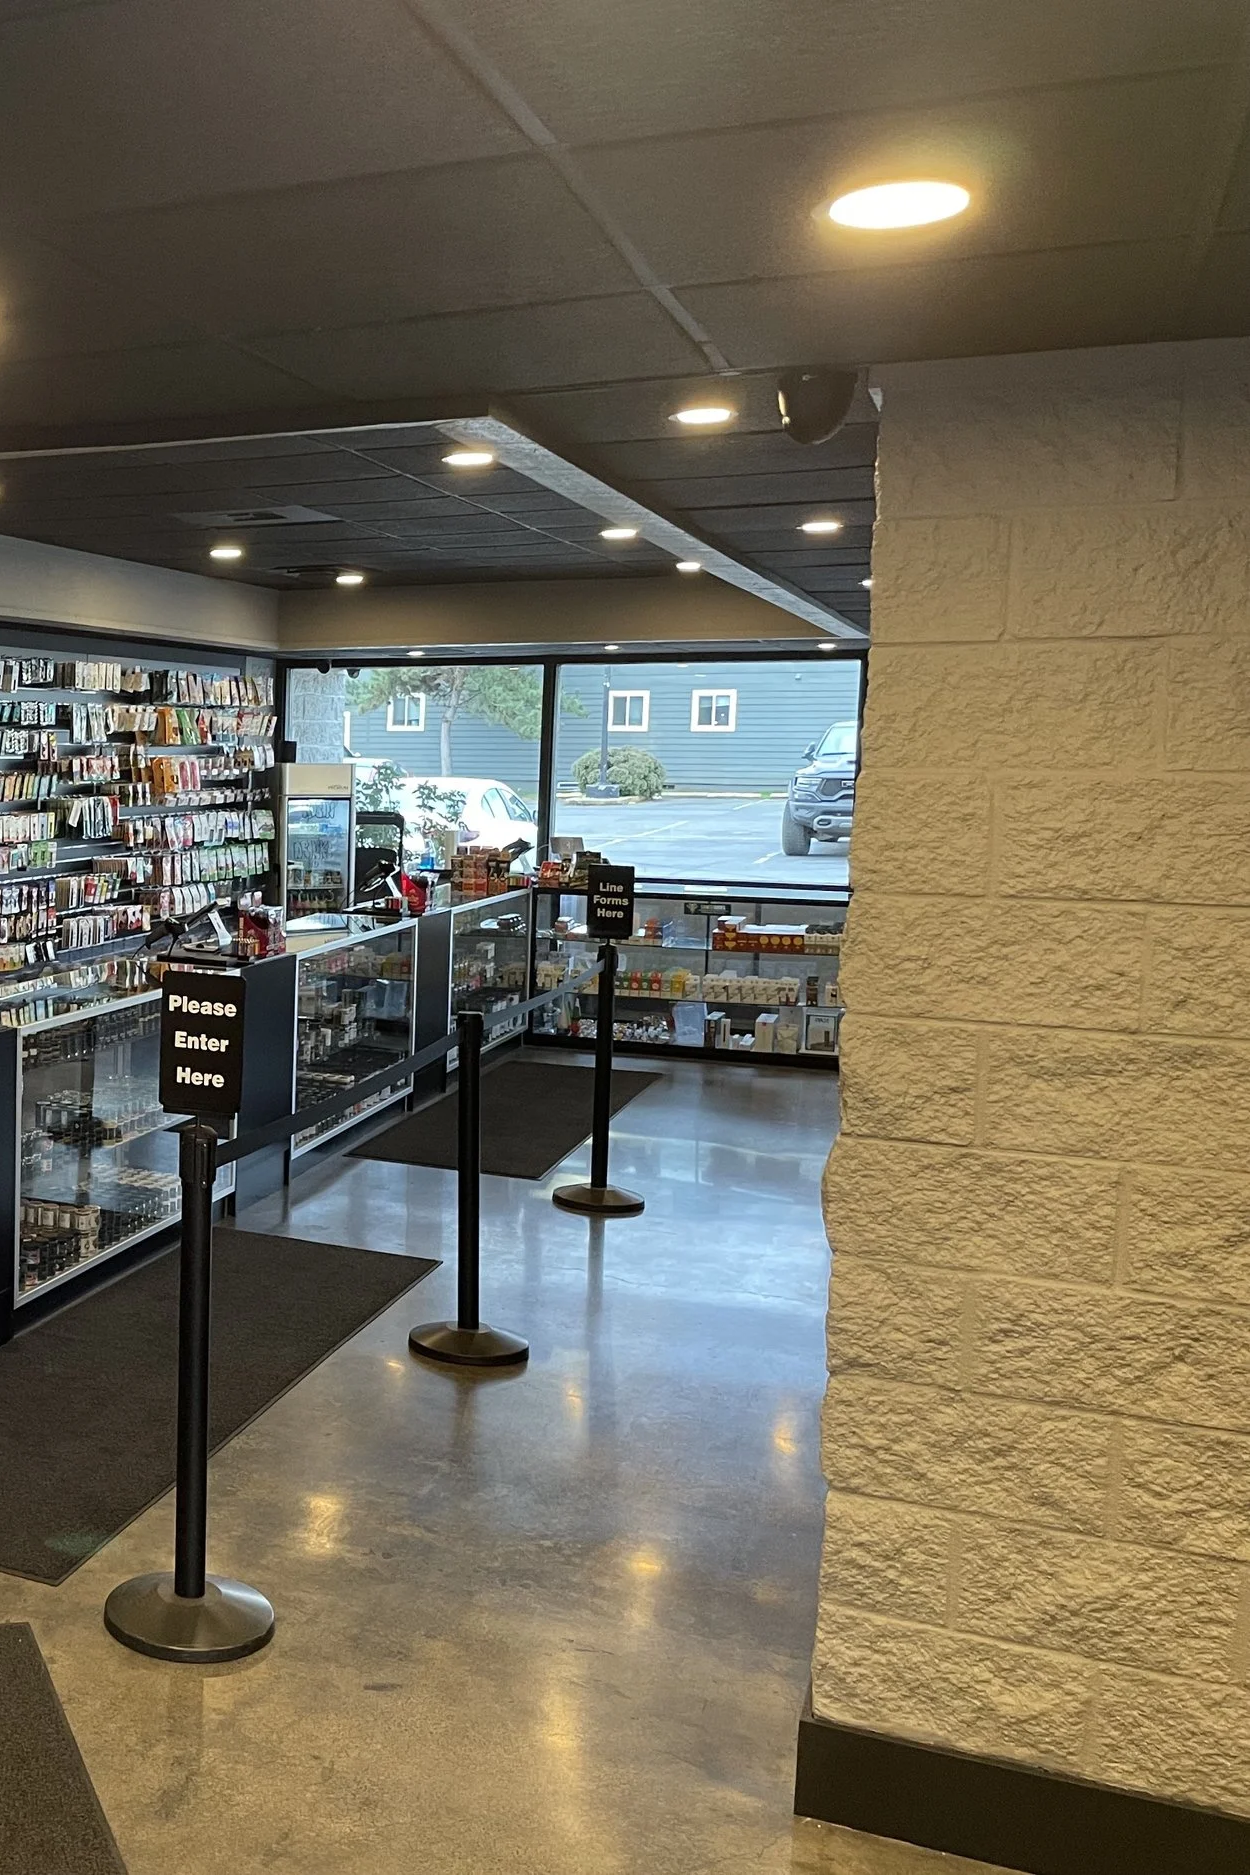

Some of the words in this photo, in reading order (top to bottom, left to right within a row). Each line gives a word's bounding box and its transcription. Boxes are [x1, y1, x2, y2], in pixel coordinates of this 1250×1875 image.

[599, 882, 624, 892] Line
[593, 895, 629, 906] Forms
[597, 908, 624, 919] Here
[168, 994, 237, 1018] Please
[174, 1030, 229, 1053] Enter
[176, 1066, 225, 1088] Here
